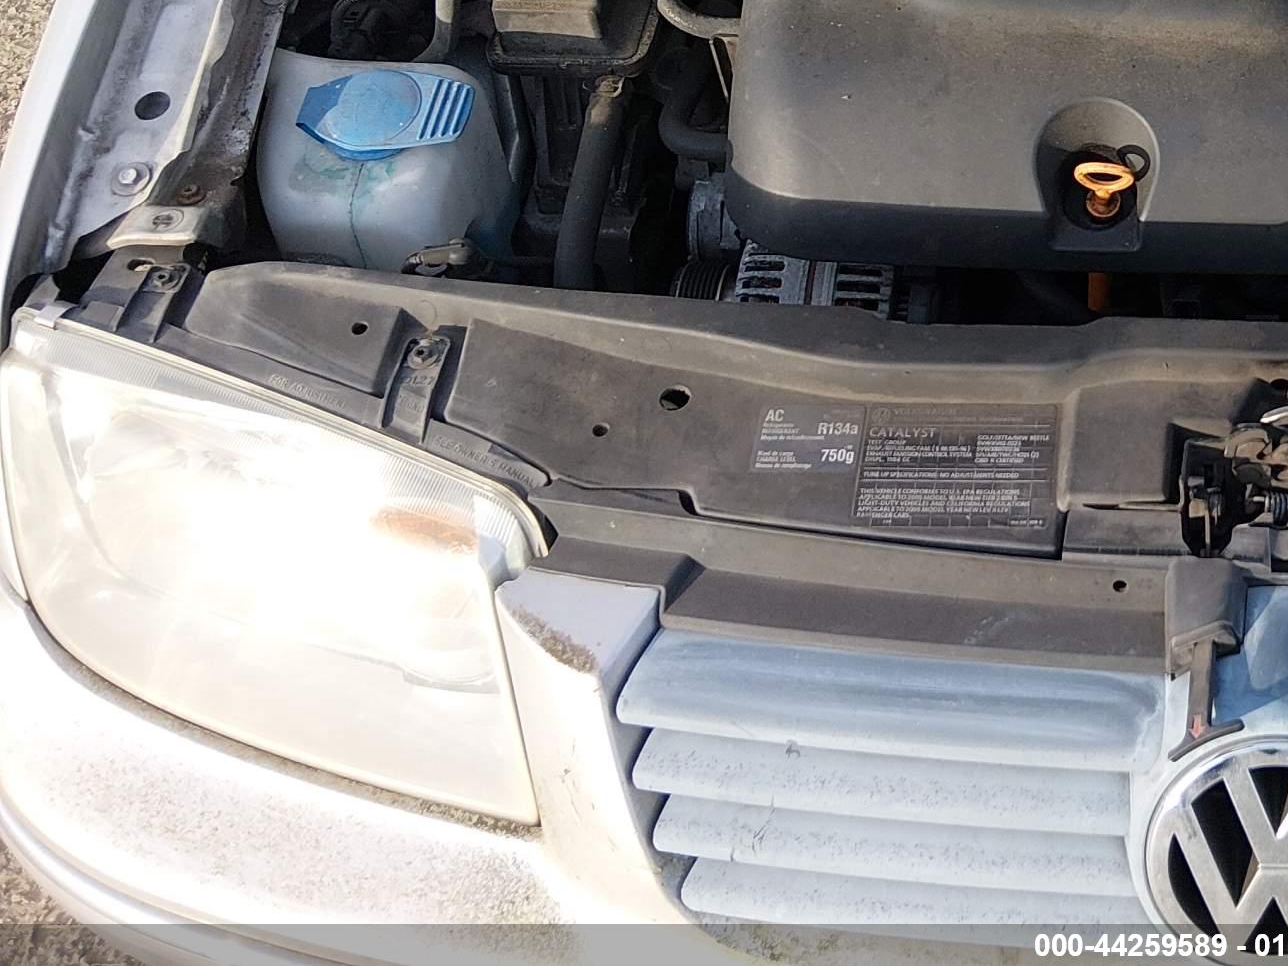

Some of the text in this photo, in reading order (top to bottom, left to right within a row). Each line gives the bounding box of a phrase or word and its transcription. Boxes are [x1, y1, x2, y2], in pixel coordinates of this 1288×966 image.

[765, 409, 784, 422] AC
[817, 422, 859, 435] R134a
[869, 427, 937, 438] CATALYST
[820, 449, 855, 464] 750g
